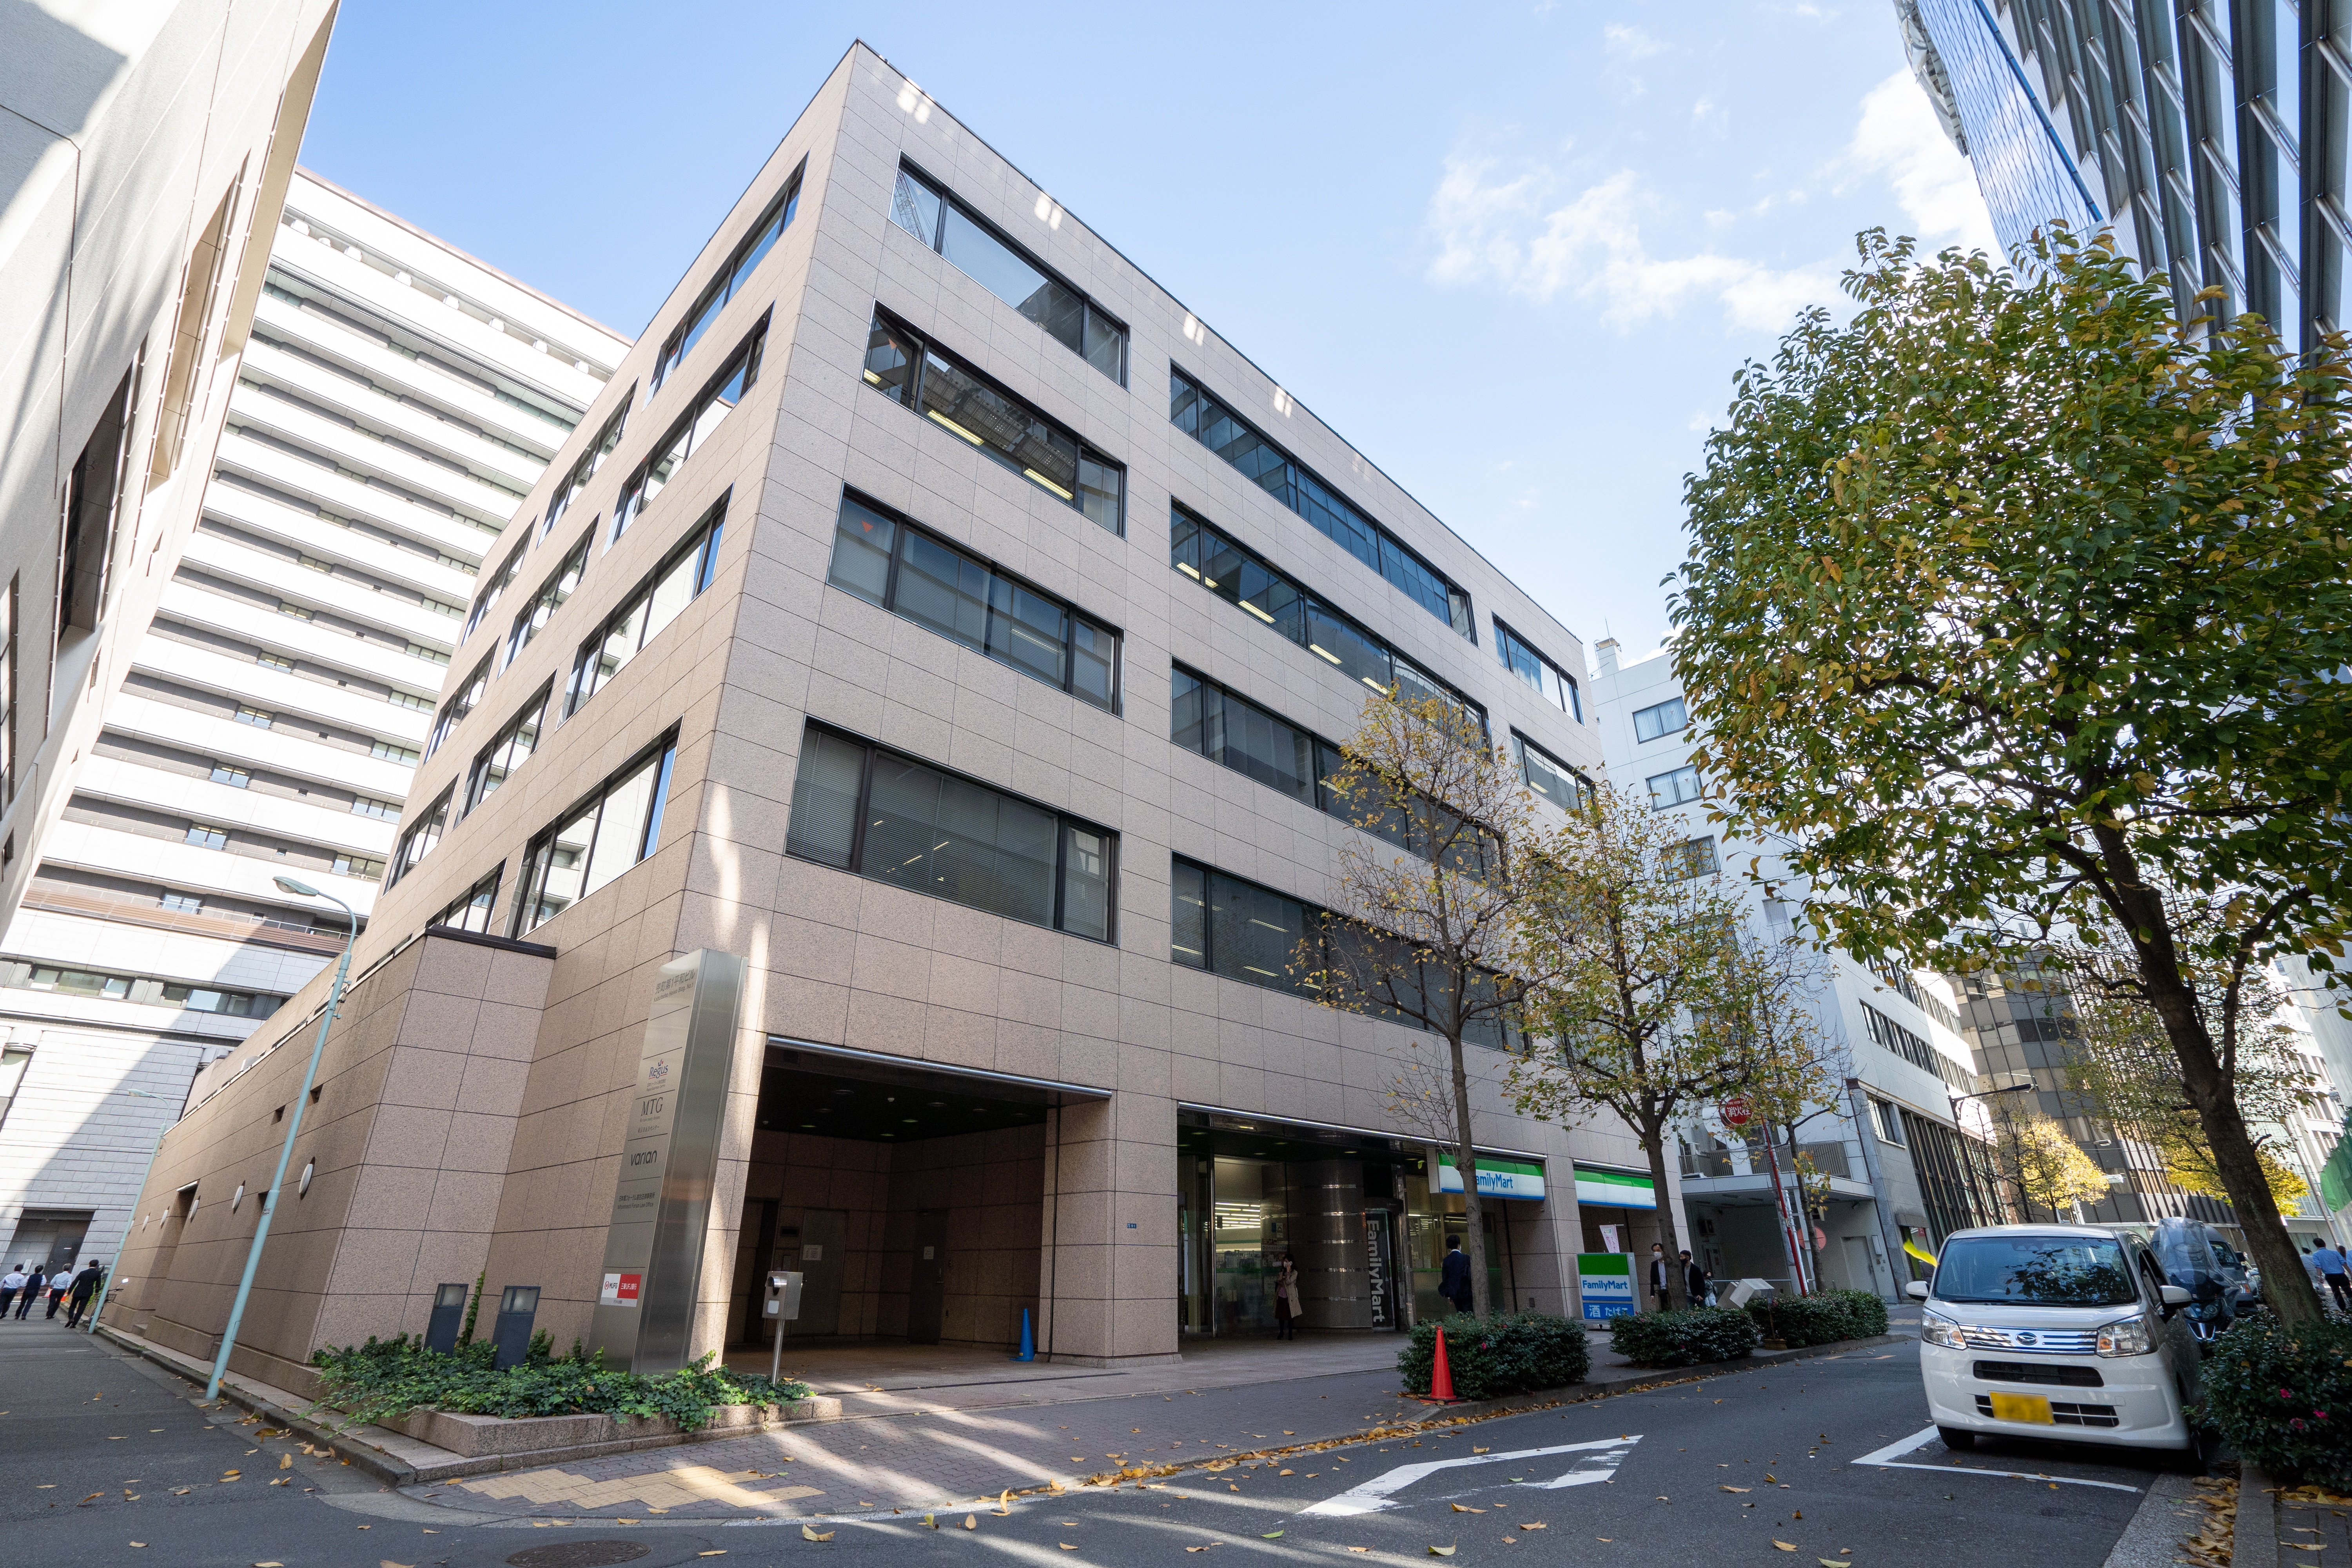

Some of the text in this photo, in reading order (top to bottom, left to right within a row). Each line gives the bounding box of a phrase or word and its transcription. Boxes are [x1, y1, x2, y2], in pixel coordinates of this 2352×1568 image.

[655, 969, 695, 995] 兜町第1平和ビル
[649, 1065, 668, 1078] Regus
[641, 1097, 663, 1116] MTG
[1726, 1104, 1751, 1117] 消火栓
[631, 1150, 657, 1166] varian
[1475, 1172, 1513, 1191] amilyMart
[1367, 1220, 1385, 1323] FamilyMart
[1582, 1280, 1628, 1291] FamilyMart
[1589, 1305, 1601, 1318] 酒
